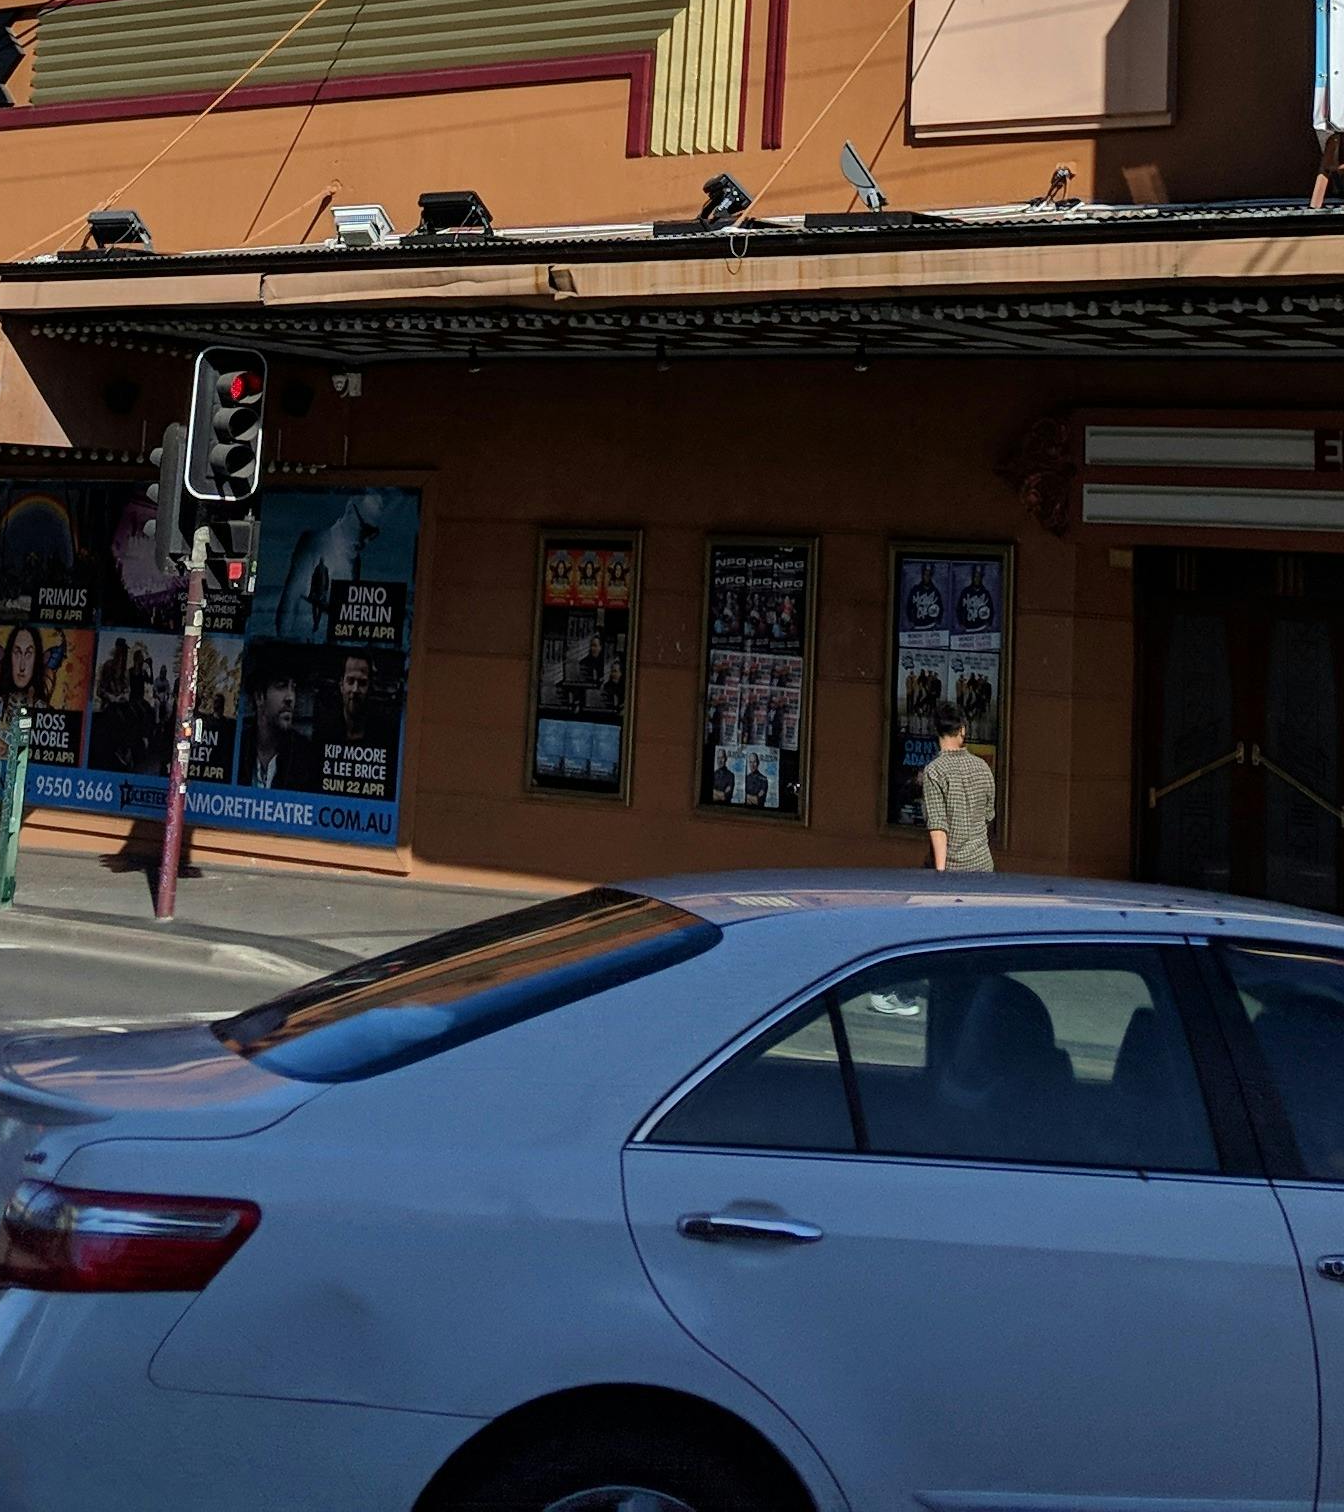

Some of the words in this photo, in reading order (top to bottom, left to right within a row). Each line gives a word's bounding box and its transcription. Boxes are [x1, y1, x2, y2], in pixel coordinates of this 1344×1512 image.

[38, 587, 88, 607] PRIMUS
[347, 586, 388, 605] DINO
[40, 608, 54, 620] FRI
[64, 609, 83, 621] APR
[339, 604, 392, 624] MERLIN
[213, 618, 234, 630] APR
[334, 624, 355, 637] SAT
[358, 625, 370, 638] 14
[371, 626, 395, 640] APR
[35, 712, 66, 730] ROSS
[30, 730, 69, 748] NOBLE
[42, 751, 54, 763] 20
[56, 752, 75, 764] APR
[325, 743, 343, 759] KIP
[343, 746, 387, 763] MOORE
[188, 764, 201, 776] 21
[203, 766, 225, 779] APR
[323, 760, 332, 774] &
[333, 762, 352, 777] LEE
[355, 763, 387, 780] BRICE
[323, 778, 344, 792] SUN
[346, 780, 360, 793] 22
[361, 782, 385, 796] APR
[36, 776, 72, 799] 9550
[76, 779, 113, 802] 3666
[184, 792, 393, 835] NMORETHEATRE.COM.AU
